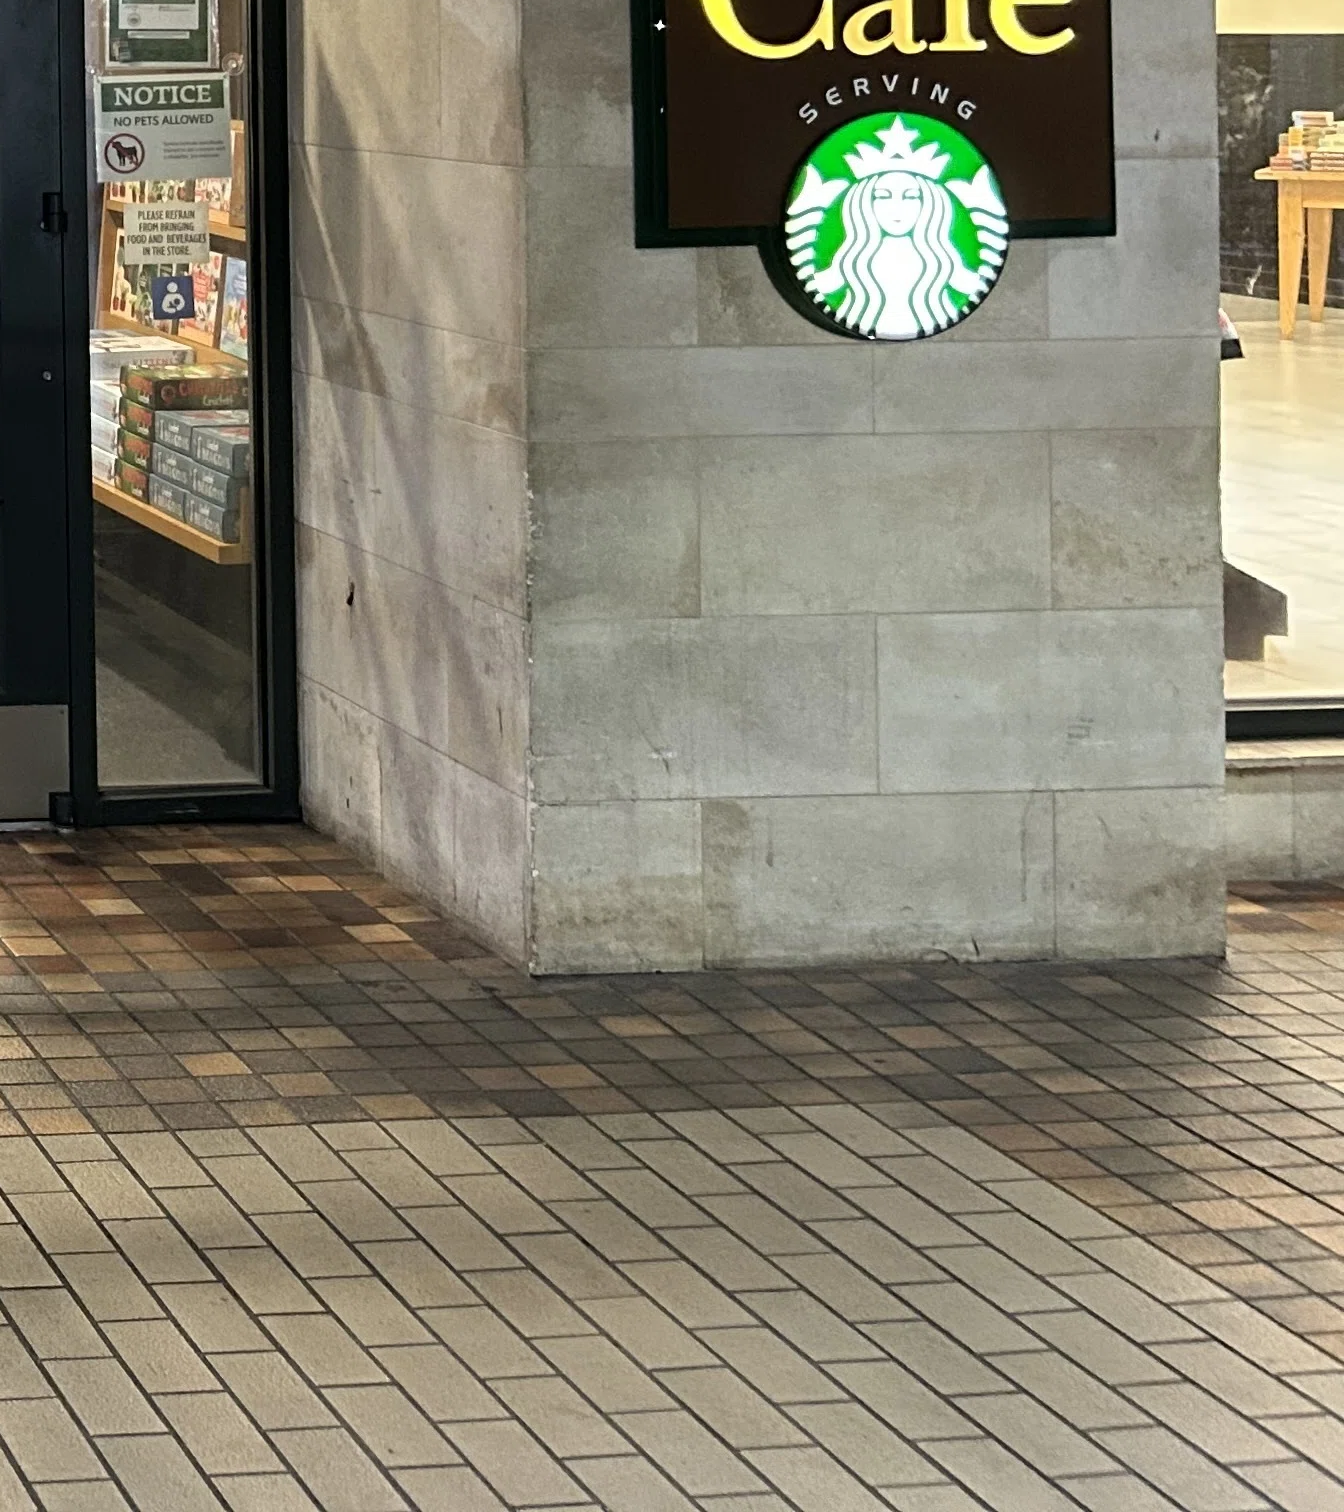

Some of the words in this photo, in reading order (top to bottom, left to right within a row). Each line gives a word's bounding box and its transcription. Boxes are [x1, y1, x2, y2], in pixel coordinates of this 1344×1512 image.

[113, 84, 212, 106] NOTICE
[798, 74, 977, 124] SERVING
[113, 117, 131, 127] NO
[134, 116, 159, 127] PETS
[161, 114, 214, 125] ALLOWED
[138, 210, 164, 220] PLEASE
[165, 210, 195, 219] REFRAIN
[139, 223, 159, 232] FROM
[160, 222, 194, 231] BRINGING
[127, 235, 147, 244] FOOD
[148, 235, 163, 243] AND
[166, 234, 206, 243] BEVERAGES
[143, 246, 151, 255] IN
[152, 246, 165, 255] THE
